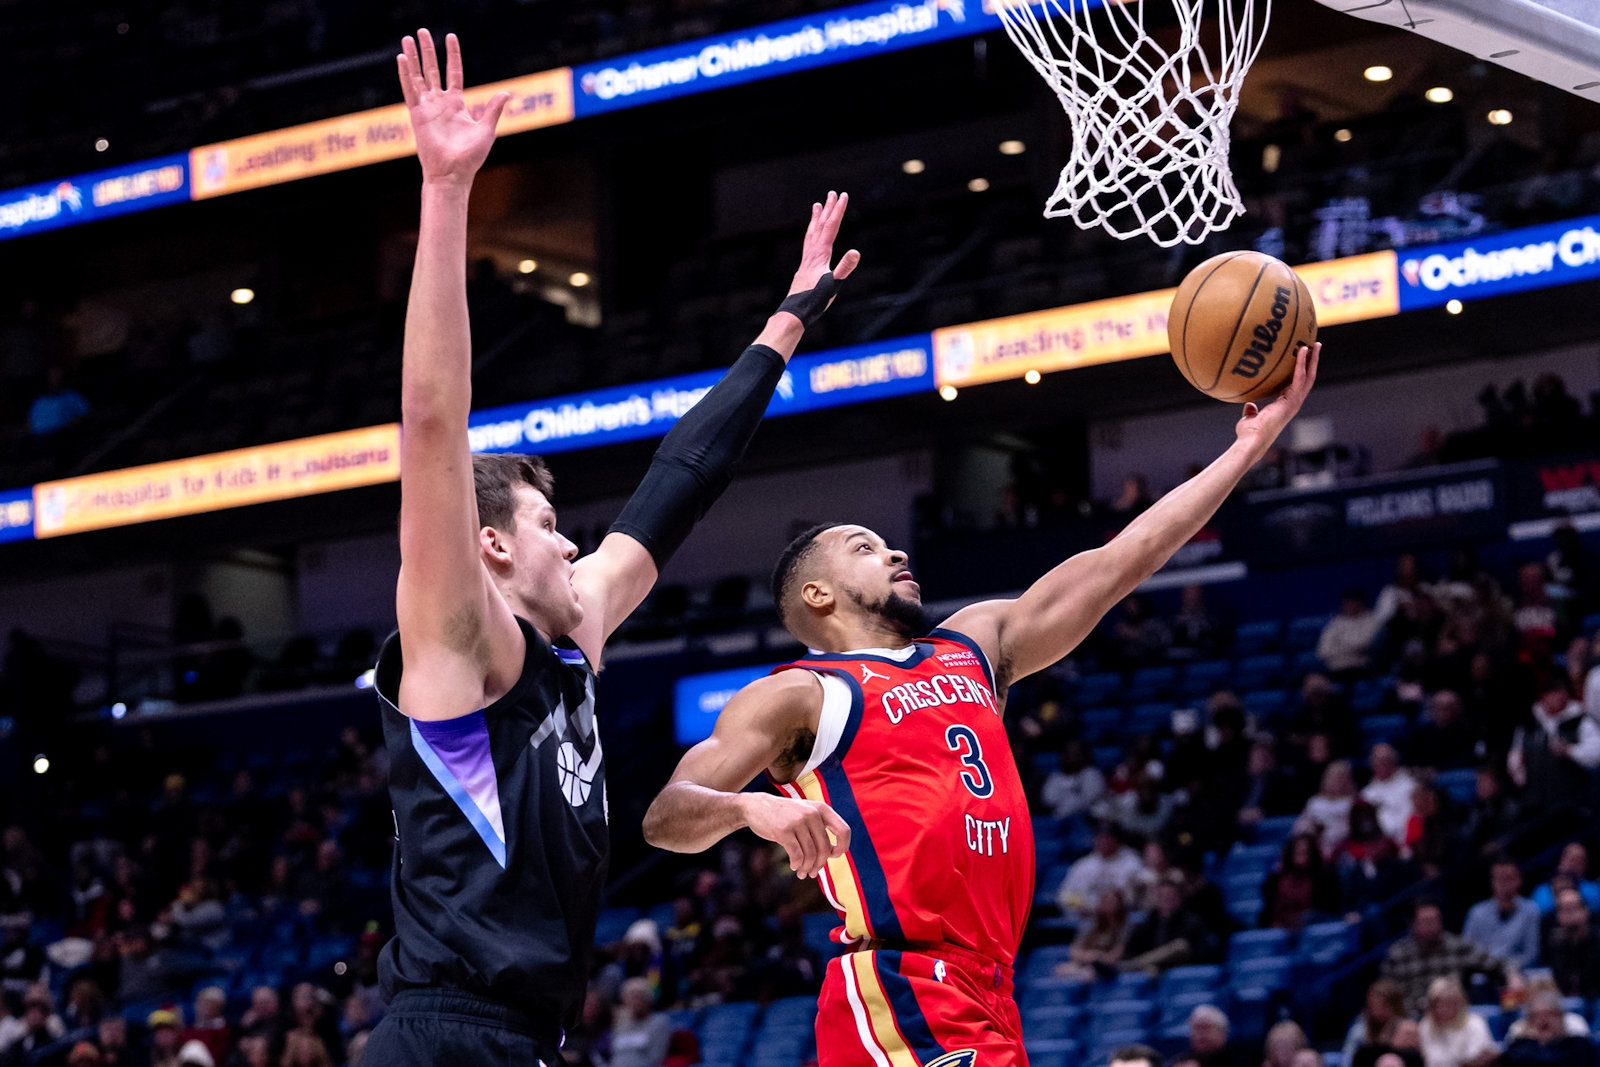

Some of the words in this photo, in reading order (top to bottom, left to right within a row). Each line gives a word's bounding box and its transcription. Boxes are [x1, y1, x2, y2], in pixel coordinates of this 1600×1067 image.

[1419, 241, 1556, 291] Ochsner
[1232, 286, 1291, 378] Wilson
[936, 650, 977, 662] NEWAGE
[944, 659, 981, 668] PRODUCTS
[881, 673, 998, 725] CRESCENT
[945, 724, 994, 799] 3
[964, 813, 1011, 857] CITY
